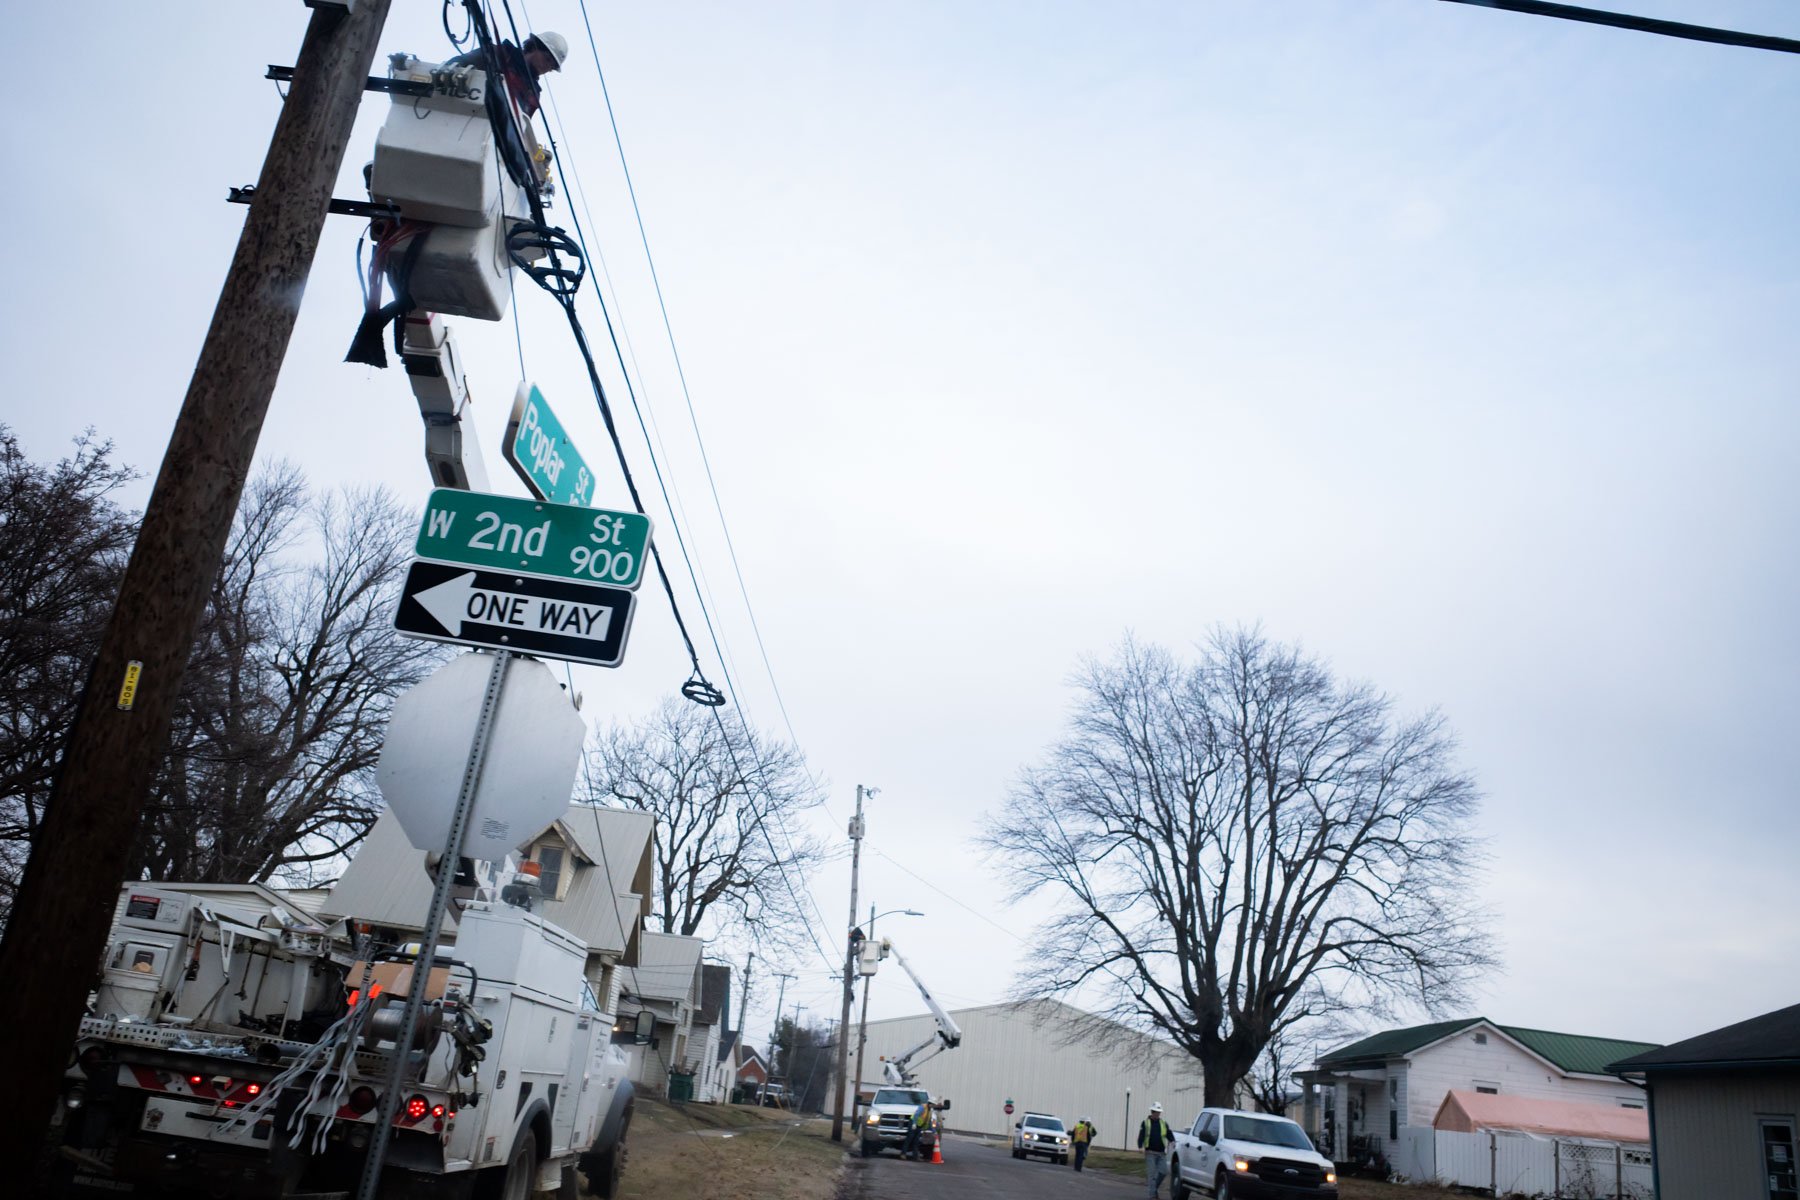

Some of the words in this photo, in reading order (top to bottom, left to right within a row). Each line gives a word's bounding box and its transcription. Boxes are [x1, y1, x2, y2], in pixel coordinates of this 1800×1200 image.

[520, 401, 565, 486] Poplar
[575, 466, 589, 503] St
[427, 508, 456, 539] W
[467, 511, 552, 557] 2nd
[589, 514, 626, 546] St
[570, 546, 634, 581] 900
[467, 592, 529, 626] ONE
[539, 601, 604, 635] WAY
